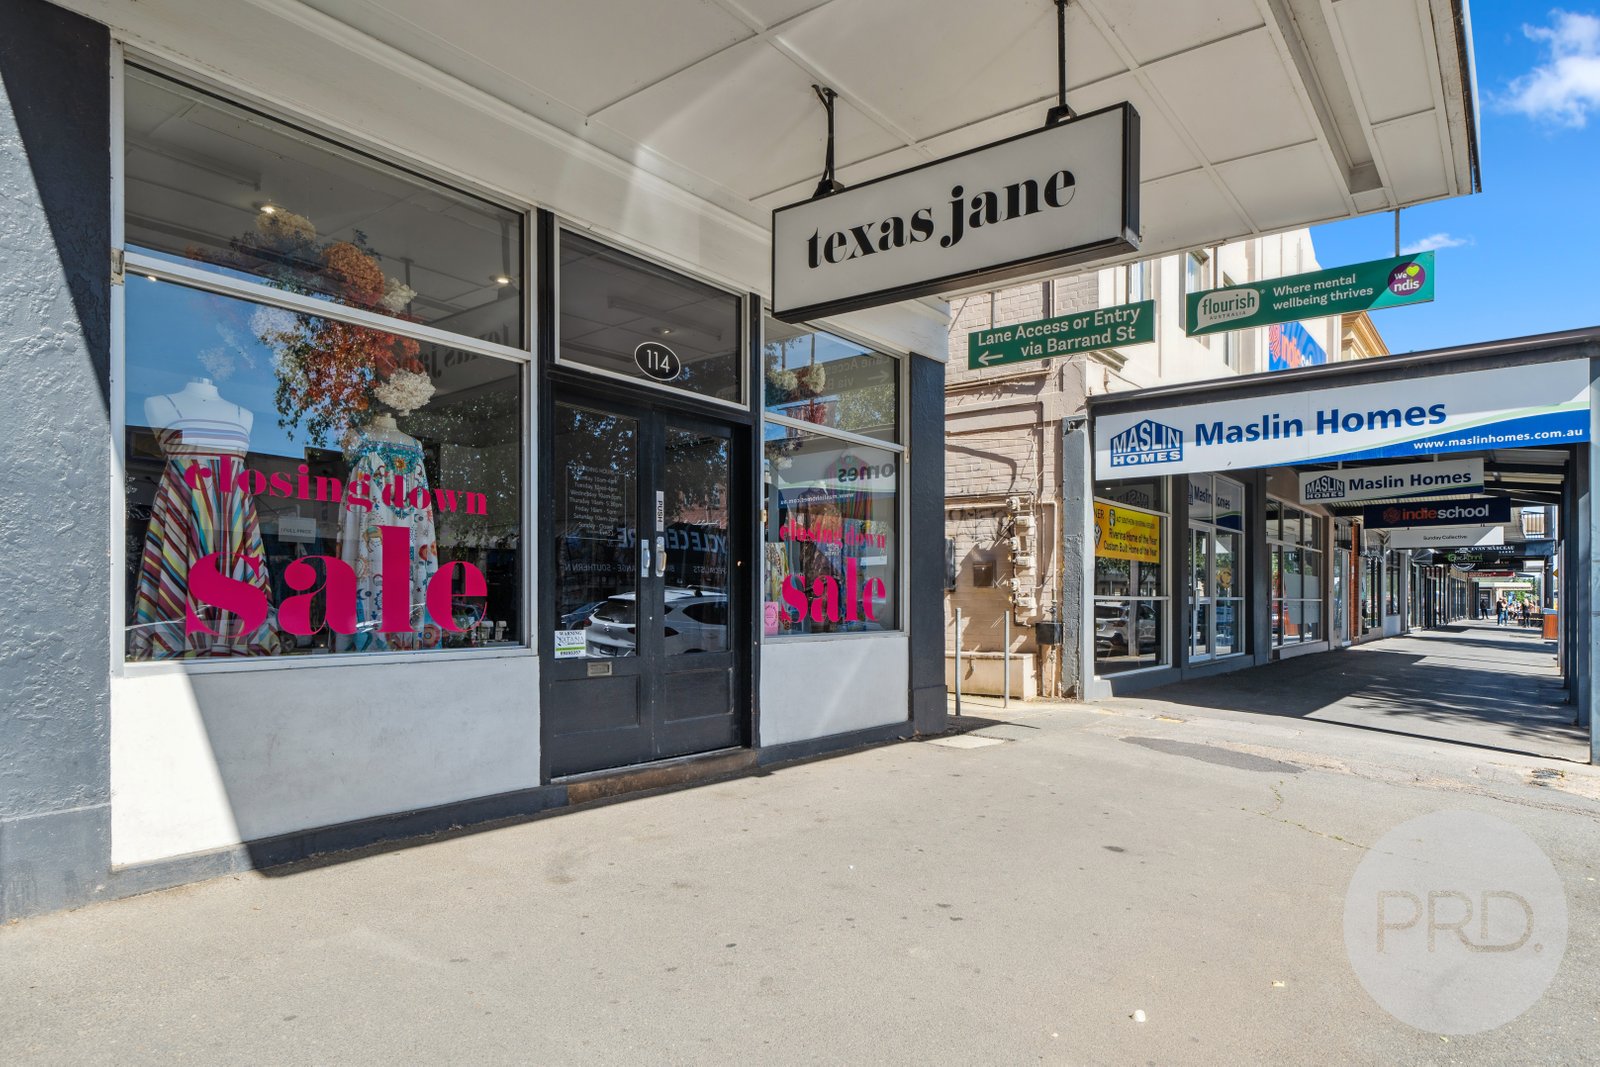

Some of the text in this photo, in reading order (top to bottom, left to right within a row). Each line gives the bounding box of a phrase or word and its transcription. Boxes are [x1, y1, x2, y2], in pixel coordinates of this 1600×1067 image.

[807, 170, 1076, 269] texas jane
[1273, 274, 1356, 296] Where mental
[1394, 272, 1407, 280] We
[1394, 279, 1420, 293] ndis
[1202, 291, 1255, 315] flourish
[1273, 286, 1373, 310] wellbeing thrives
[978, 307, 1140, 346] Lane Access or Entry
[1209, 311, 1247, 320] AUSTRALIA
[1021, 326, 1136, 356] via Barrand St
[647, 350, 670, 373] 114
[1195, 402, 1446, 446] Maslin Homes
[1113, 421, 1180, 453] MASLIN
[1413, 428, 1583, 450] www.maslinhomes.com.au
[1112, 450, 1181, 465] HOMES
[184, 454, 489, 516] closing down
[1305, 475, 1344, 494] MASLIN
[1349, 472, 1471, 491] Maslin Homes
[1306, 490, 1344, 499] HOMES
[780, 518, 886, 549] closing down
[185, 525, 489, 639] sale
[781, 557, 887, 623] sale
